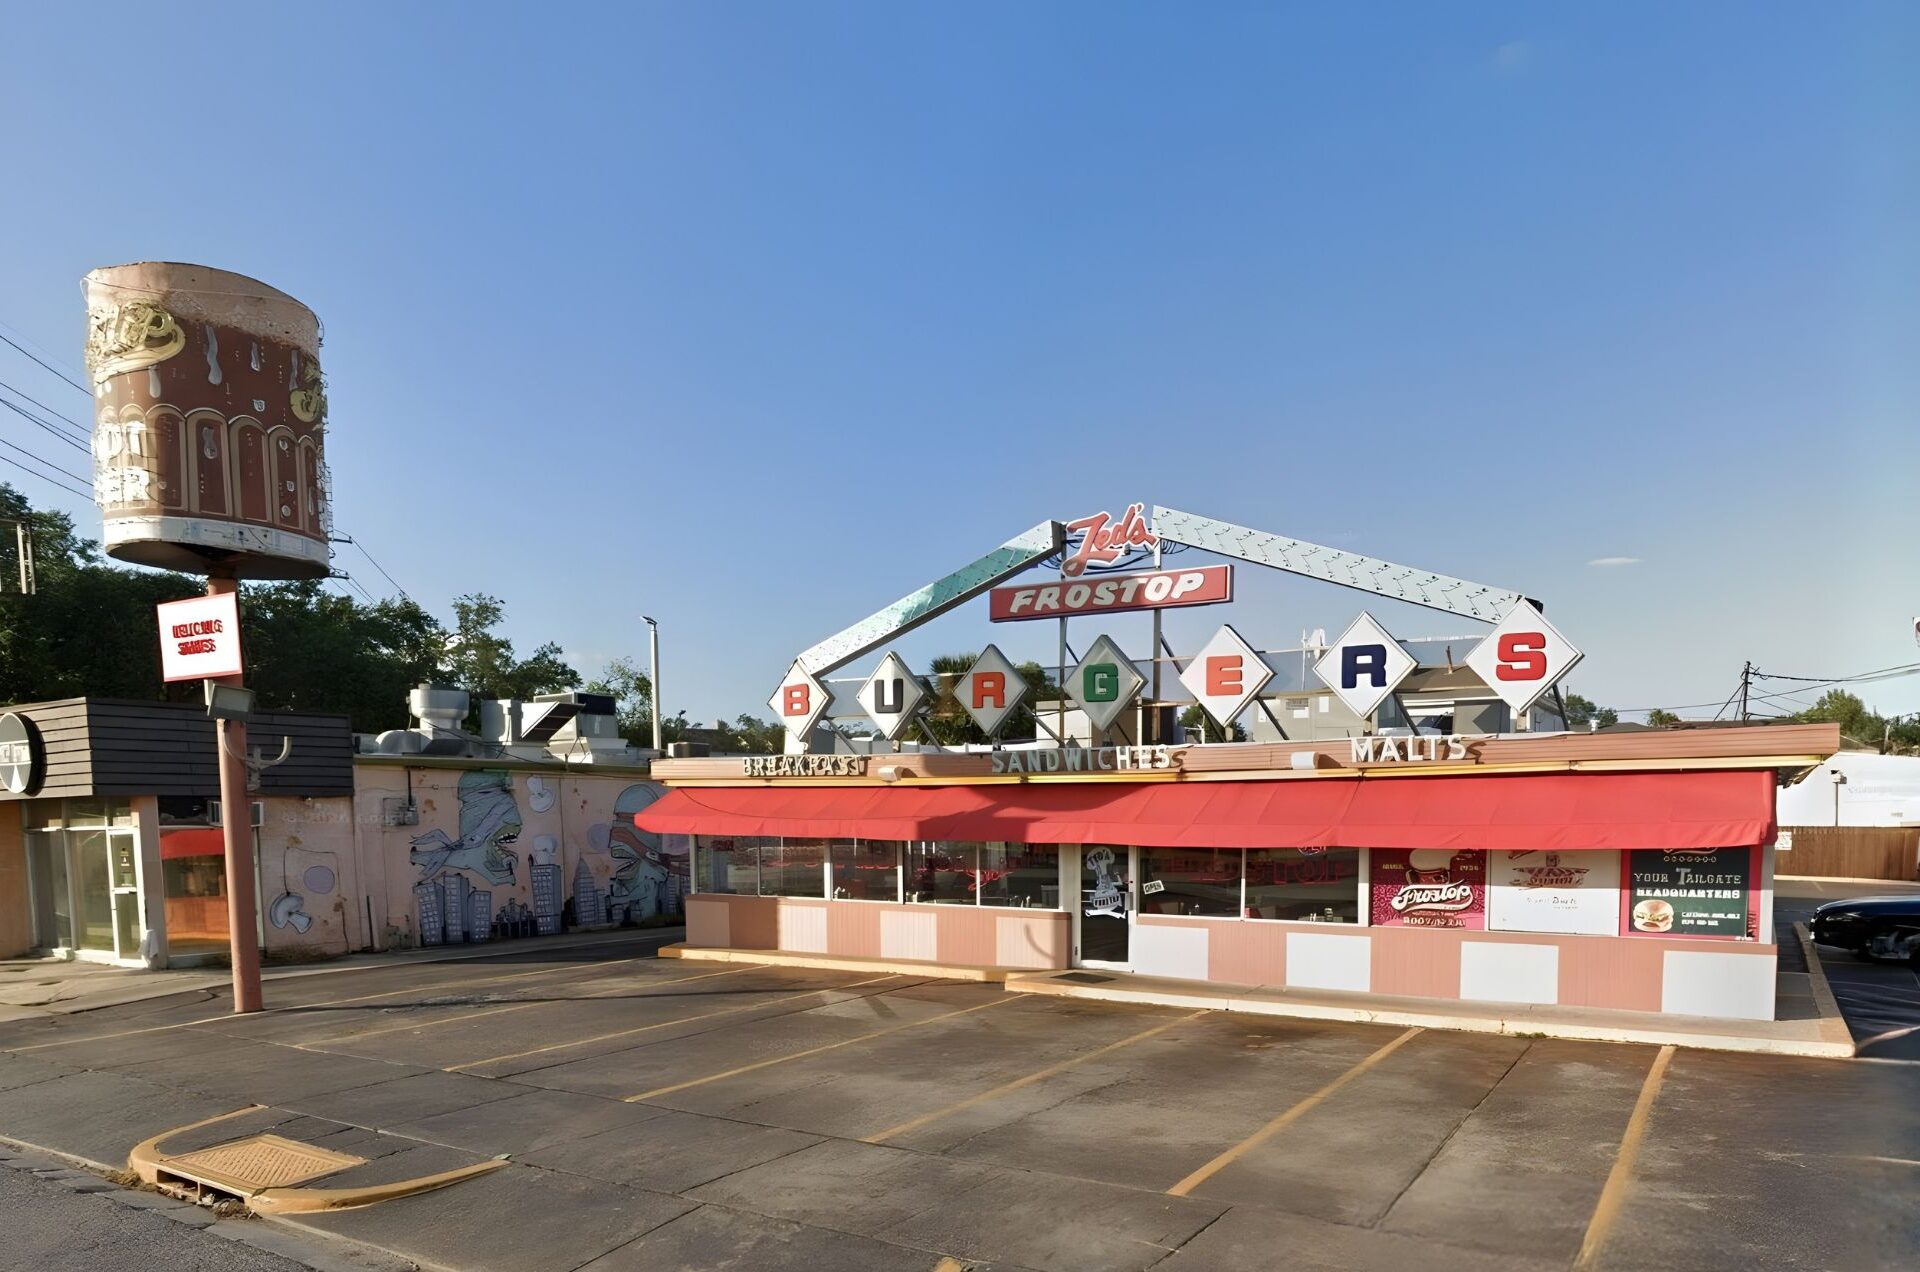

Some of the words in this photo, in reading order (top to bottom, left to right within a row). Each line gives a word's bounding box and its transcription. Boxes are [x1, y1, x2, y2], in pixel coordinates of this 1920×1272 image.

[1062, 502, 1159, 577] Ted's
[1009, 572, 1204, 613] FROSTOP
[992, 744, 1171, 773] SANDWICHES
[1351, 734, 1467, 763] MALTS
[1144, 882, 1162, 893] OPEN
[1675, 867, 1742, 885] TAILGATE
[1391, 879, 1473, 912] Frostop
